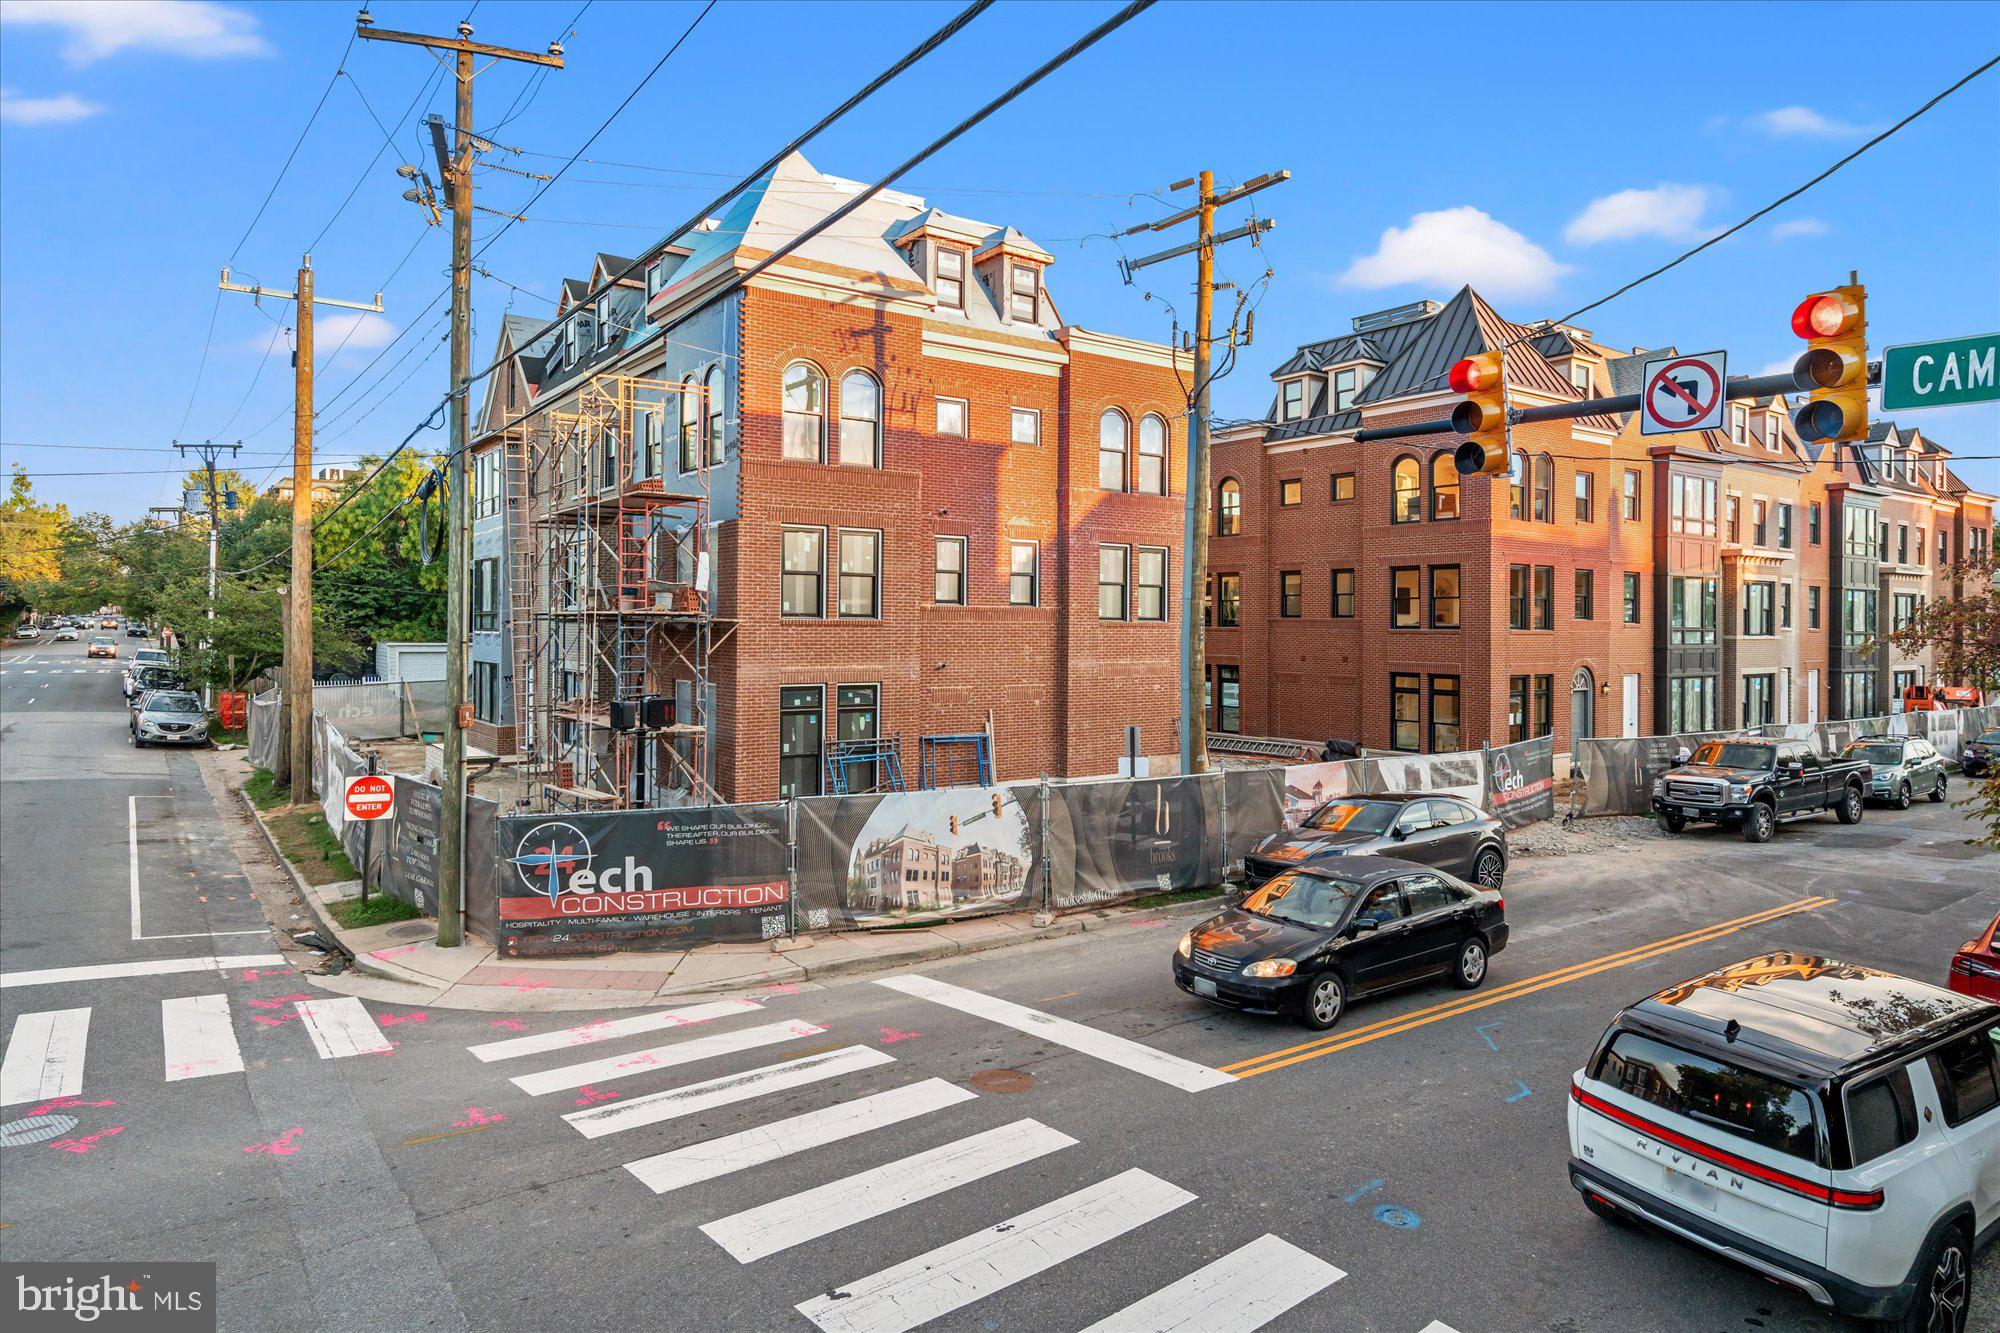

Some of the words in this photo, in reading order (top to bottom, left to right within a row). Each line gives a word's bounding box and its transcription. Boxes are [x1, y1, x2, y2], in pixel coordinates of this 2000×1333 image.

[356, 803, 383, 811] ENTER
[681, 824, 709, 832] SHAPE
[738, 828, 780, 837] BUILDINGS
[666, 839, 694, 847] SHAPE
[561, 885, 784, 914] CONSTRUCTION
[505, 919, 561, 928] HOSPITALITY
[568, 915, 627, 925] MULTI-FAMILY
[633, 910, 690, 922] WAREHOUSE
[696, 909, 741, 917] INTERIORS
[749, 904, 783, 914] TENANT
[1636, 1137, 1745, 1190] RIVIAN
